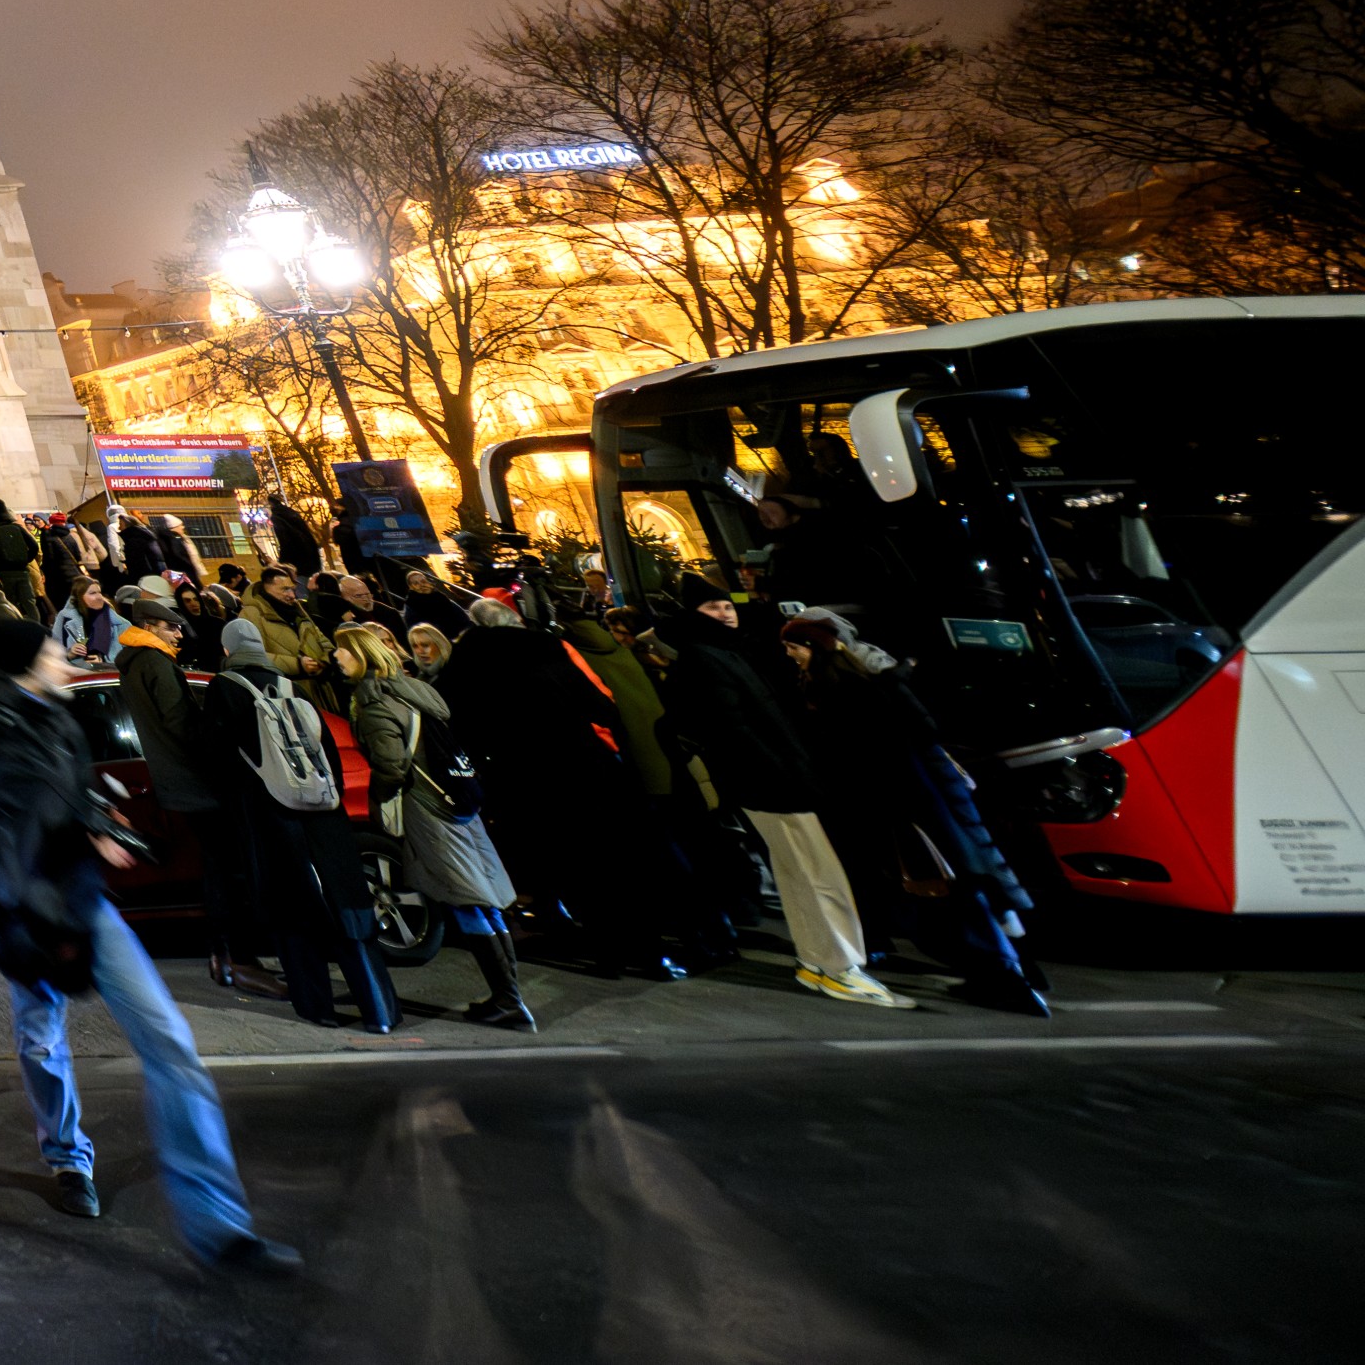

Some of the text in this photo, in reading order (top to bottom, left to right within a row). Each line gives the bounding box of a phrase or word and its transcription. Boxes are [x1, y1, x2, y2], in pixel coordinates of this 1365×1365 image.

[483, 144, 642, 171] HOTEL REGINA
[99, 438, 131, 446] Günstige
[132, 438, 176, 446] Christbäume
[180, 438, 202, 446] direkt
[218, 438, 243, 446] Bauern
[110, 478, 224, 488] HERZLICH WILLKOMMEN
